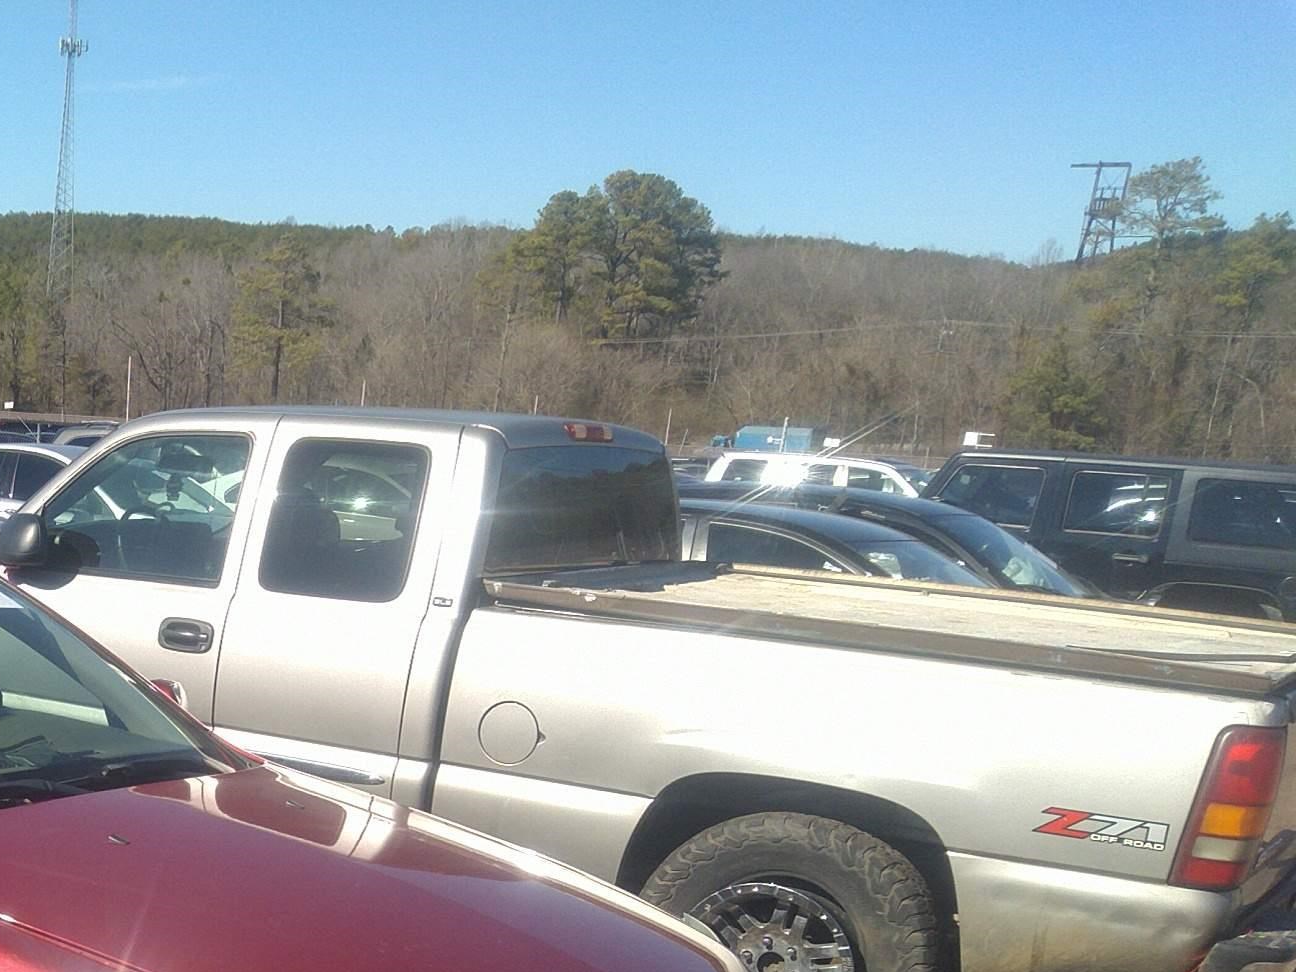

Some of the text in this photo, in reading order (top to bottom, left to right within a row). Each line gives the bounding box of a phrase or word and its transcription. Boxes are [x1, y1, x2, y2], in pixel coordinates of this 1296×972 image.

[1032, 807, 1170, 845] Z71
[1089, 833, 1165, 851] OFF ROAD
